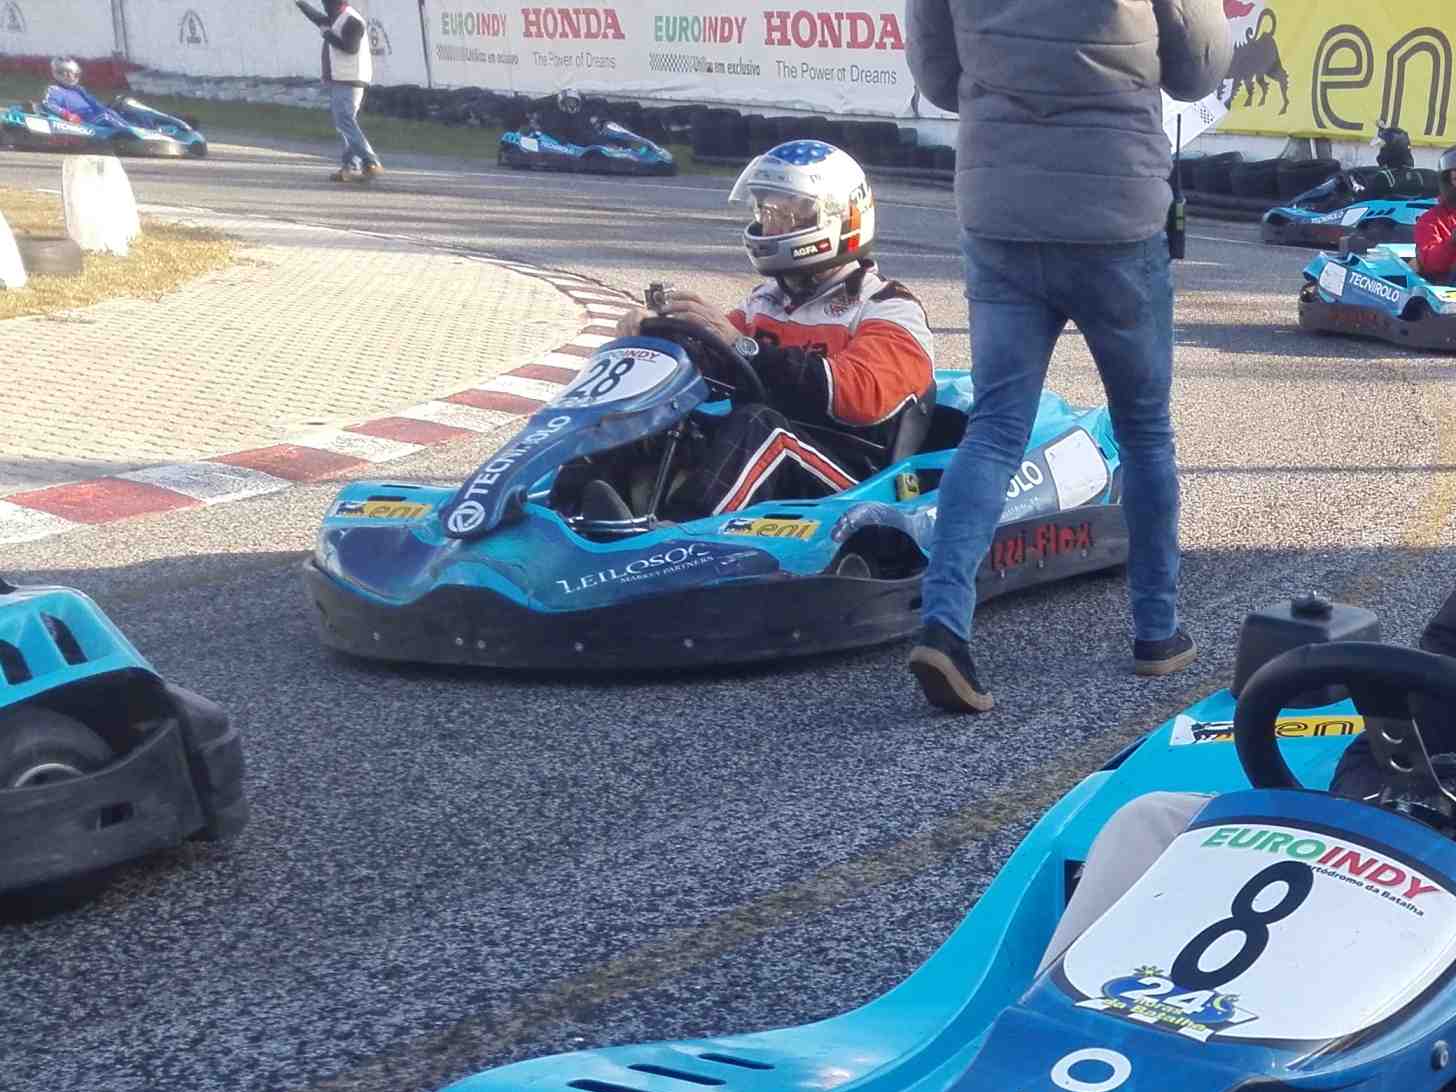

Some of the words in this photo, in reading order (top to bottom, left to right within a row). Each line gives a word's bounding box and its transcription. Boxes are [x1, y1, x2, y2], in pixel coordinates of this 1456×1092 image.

[441, 12, 506, 37] EUROINDY
[521, 8, 625, 40] HONDA
[655, 15, 747, 44] EUROINDY
[763, 10, 905, 50] HONDA
[776, 60, 797, 80] The
[800, 62, 834, 81] Power
[850, 64, 897, 85] Dreams
[1349, 272, 1400, 303] TECNIROLO
[562, 358, 635, 399] 28
[556, 543, 710, 594] LEILOSOC
[1277, 720, 1356, 738] en
[1200, 827, 1440, 901] EUROINDY
[1308, 863, 1364, 888] rtódromo
[1365, 883, 1380, 895] da
[1381, 891, 1425, 917] Batalha
[1171, 860, 1315, 990] 8
[1118, 976, 1216, 1015] 24
